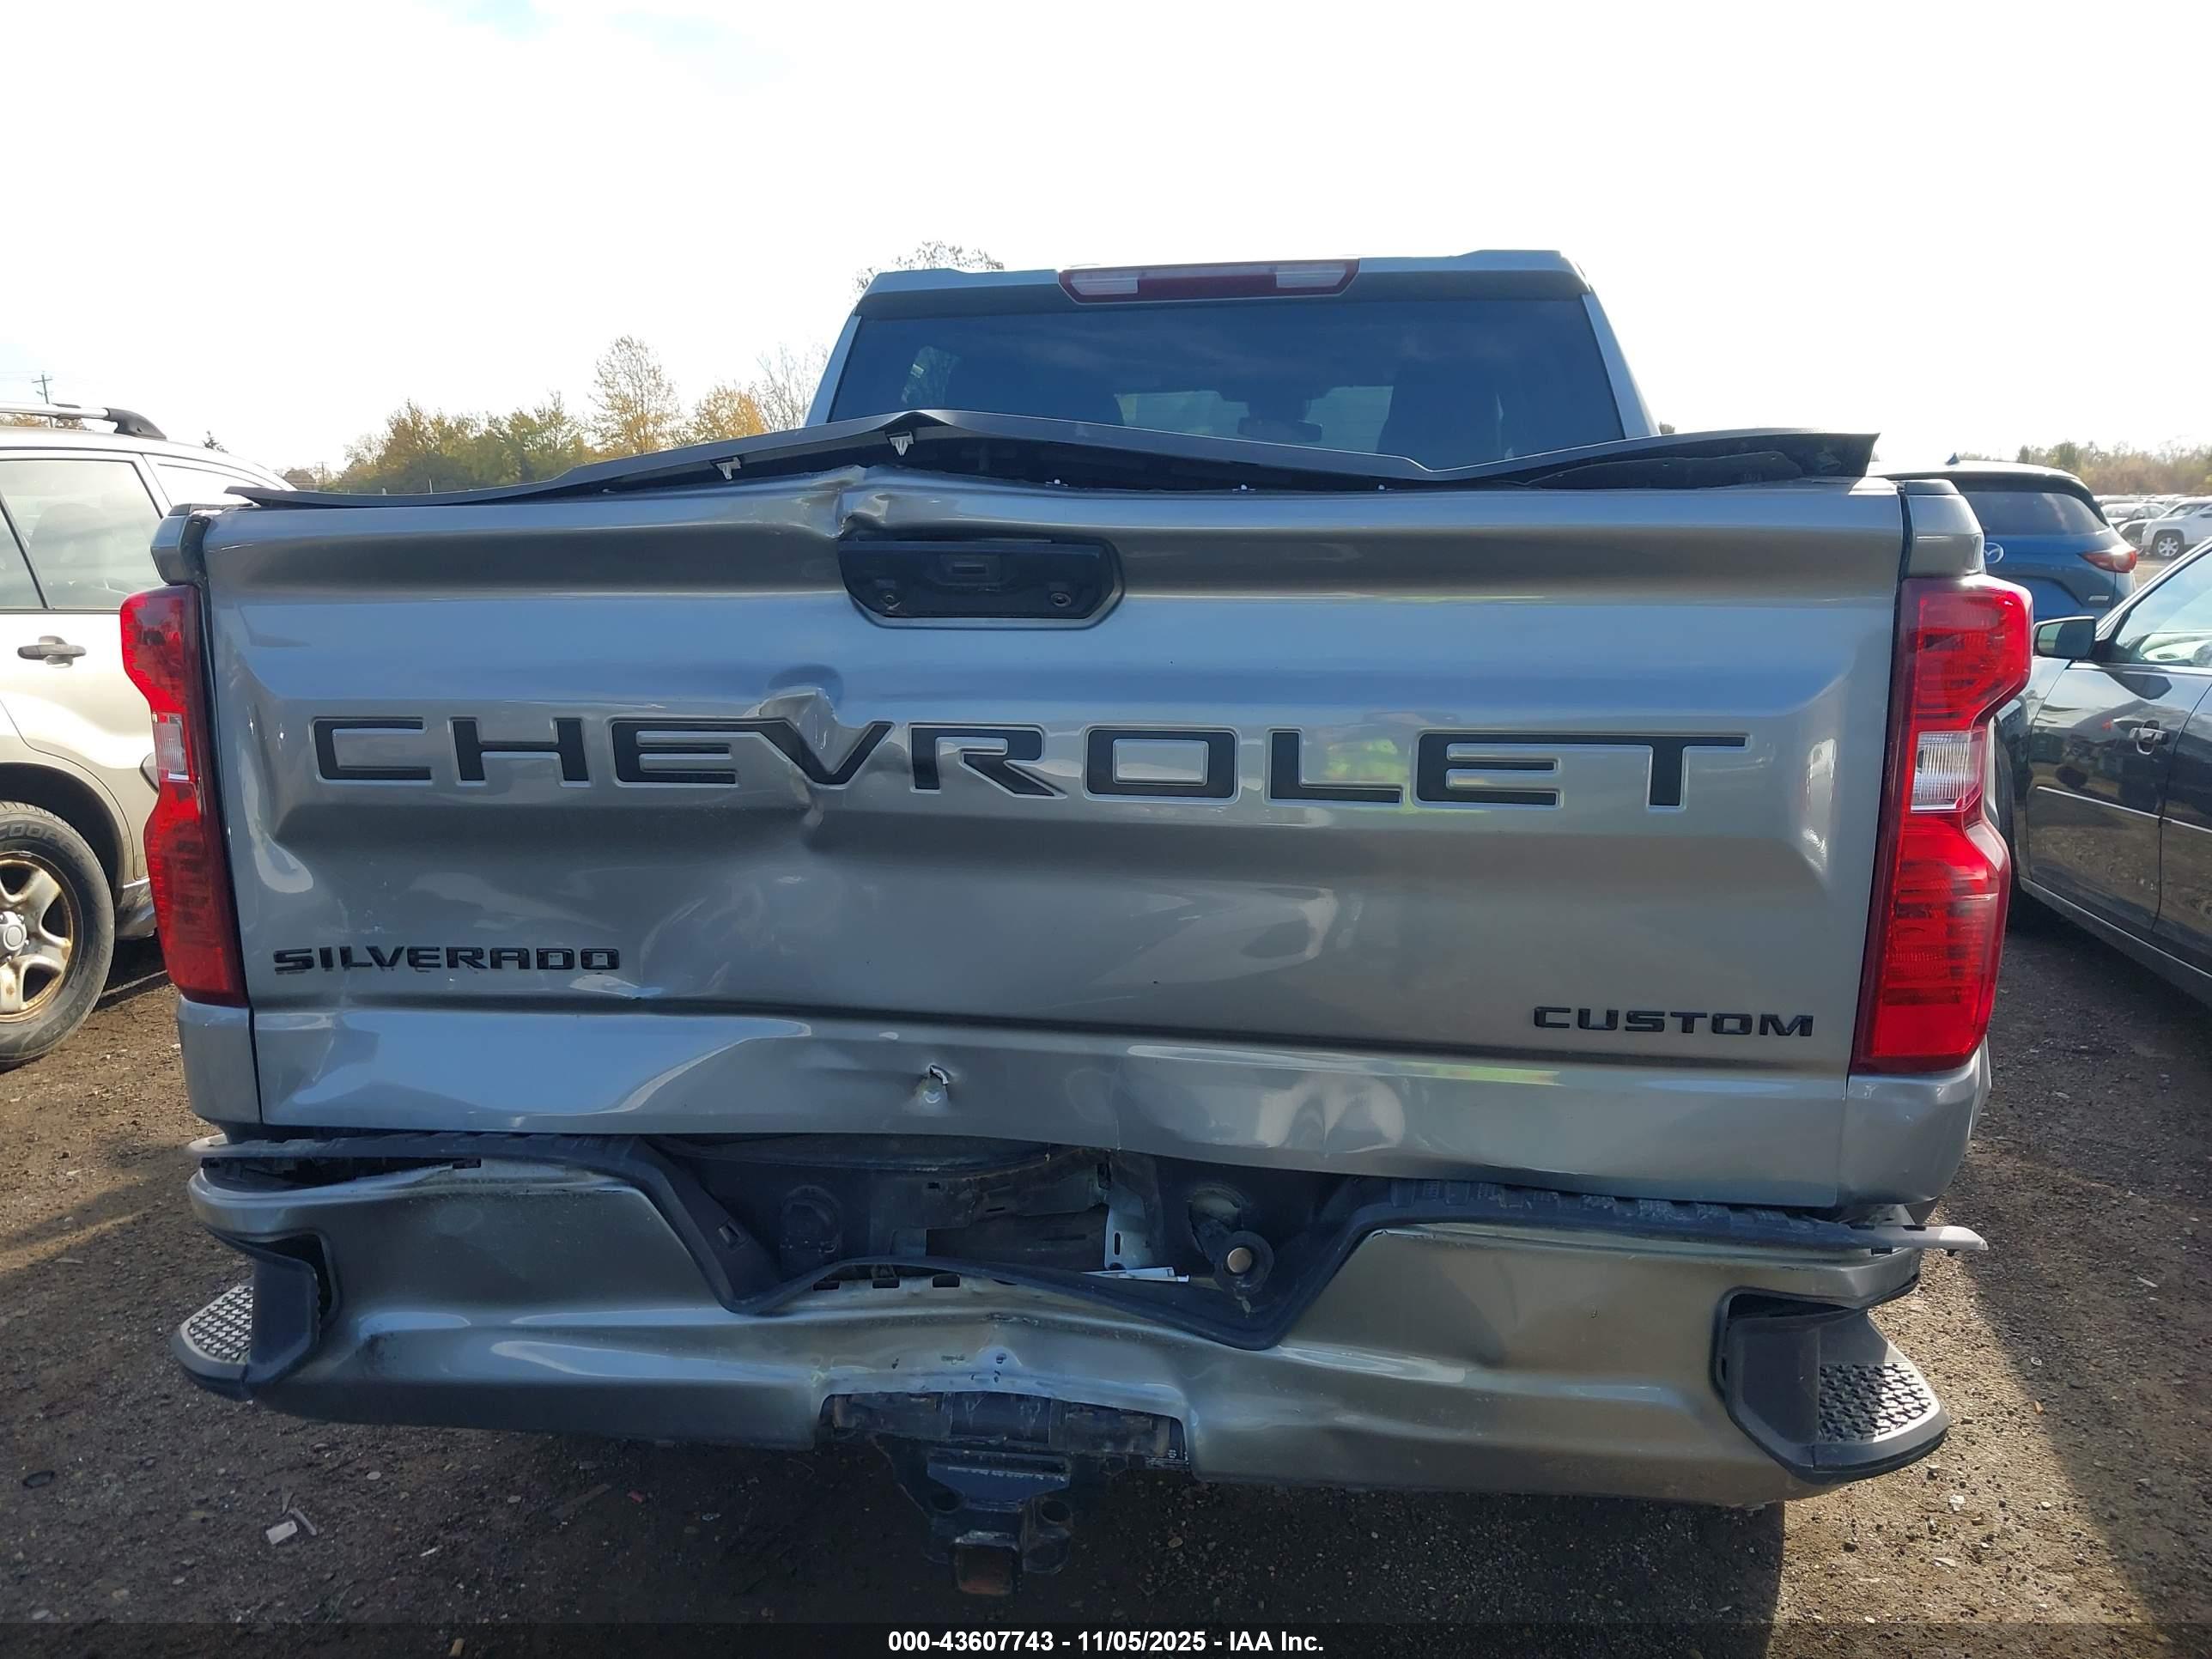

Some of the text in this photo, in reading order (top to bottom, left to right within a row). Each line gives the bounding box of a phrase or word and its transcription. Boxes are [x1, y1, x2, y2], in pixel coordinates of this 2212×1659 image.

[313, 716, 1747, 807] CHEVROLET
[273, 945, 620, 971] SILVERADO
[1534, 1006, 1814, 1037] CUSTOM
